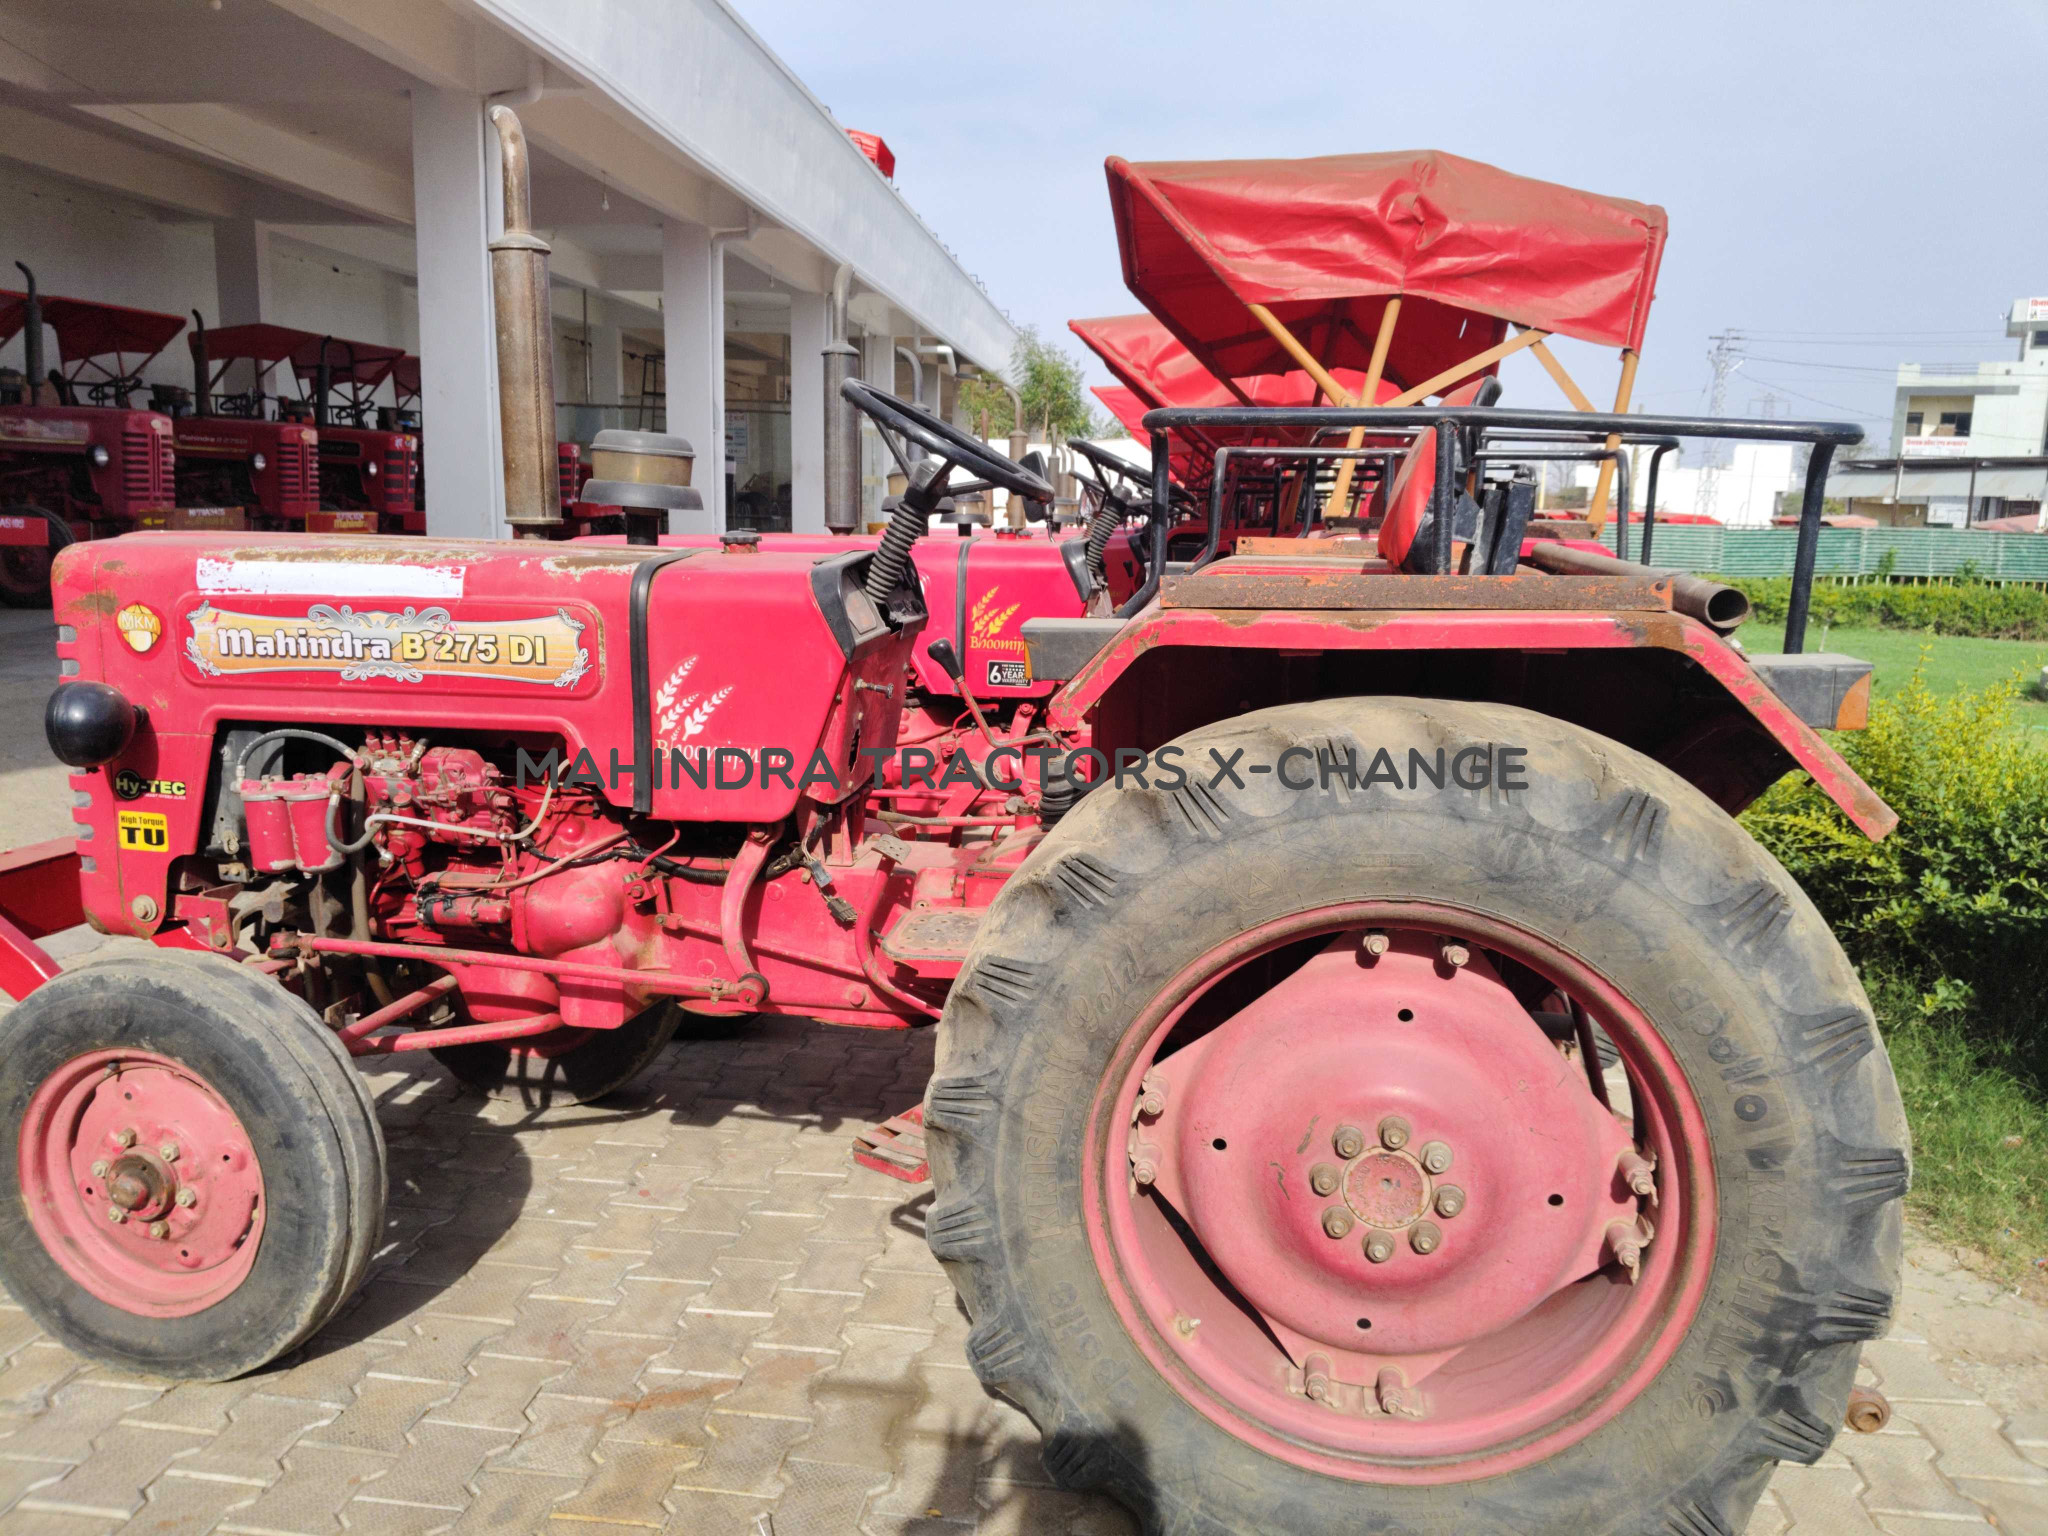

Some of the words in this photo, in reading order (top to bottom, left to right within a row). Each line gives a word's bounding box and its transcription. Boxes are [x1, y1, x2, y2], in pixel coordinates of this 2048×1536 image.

[121, 611, 156, 630] MKM
[218, 628, 392, 660] Mahindra
[401, 631, 426, 661] B
[434, 634, 499, 663] 275
[509, 635, 547, 664] DI
[970, 635, 1025, 655] Bhoomip
[989, 665, 1002, 684] 6
[1002, 671, 1026, 680] YEAR
[654, 739, 789, 770] Bhoomipu
[115, 777, 186, 795] Hy-TEC
[121, 815, 137, 824] High
[139, 816, 164, 826] Torque
[121, 826, 165, 846] TU
